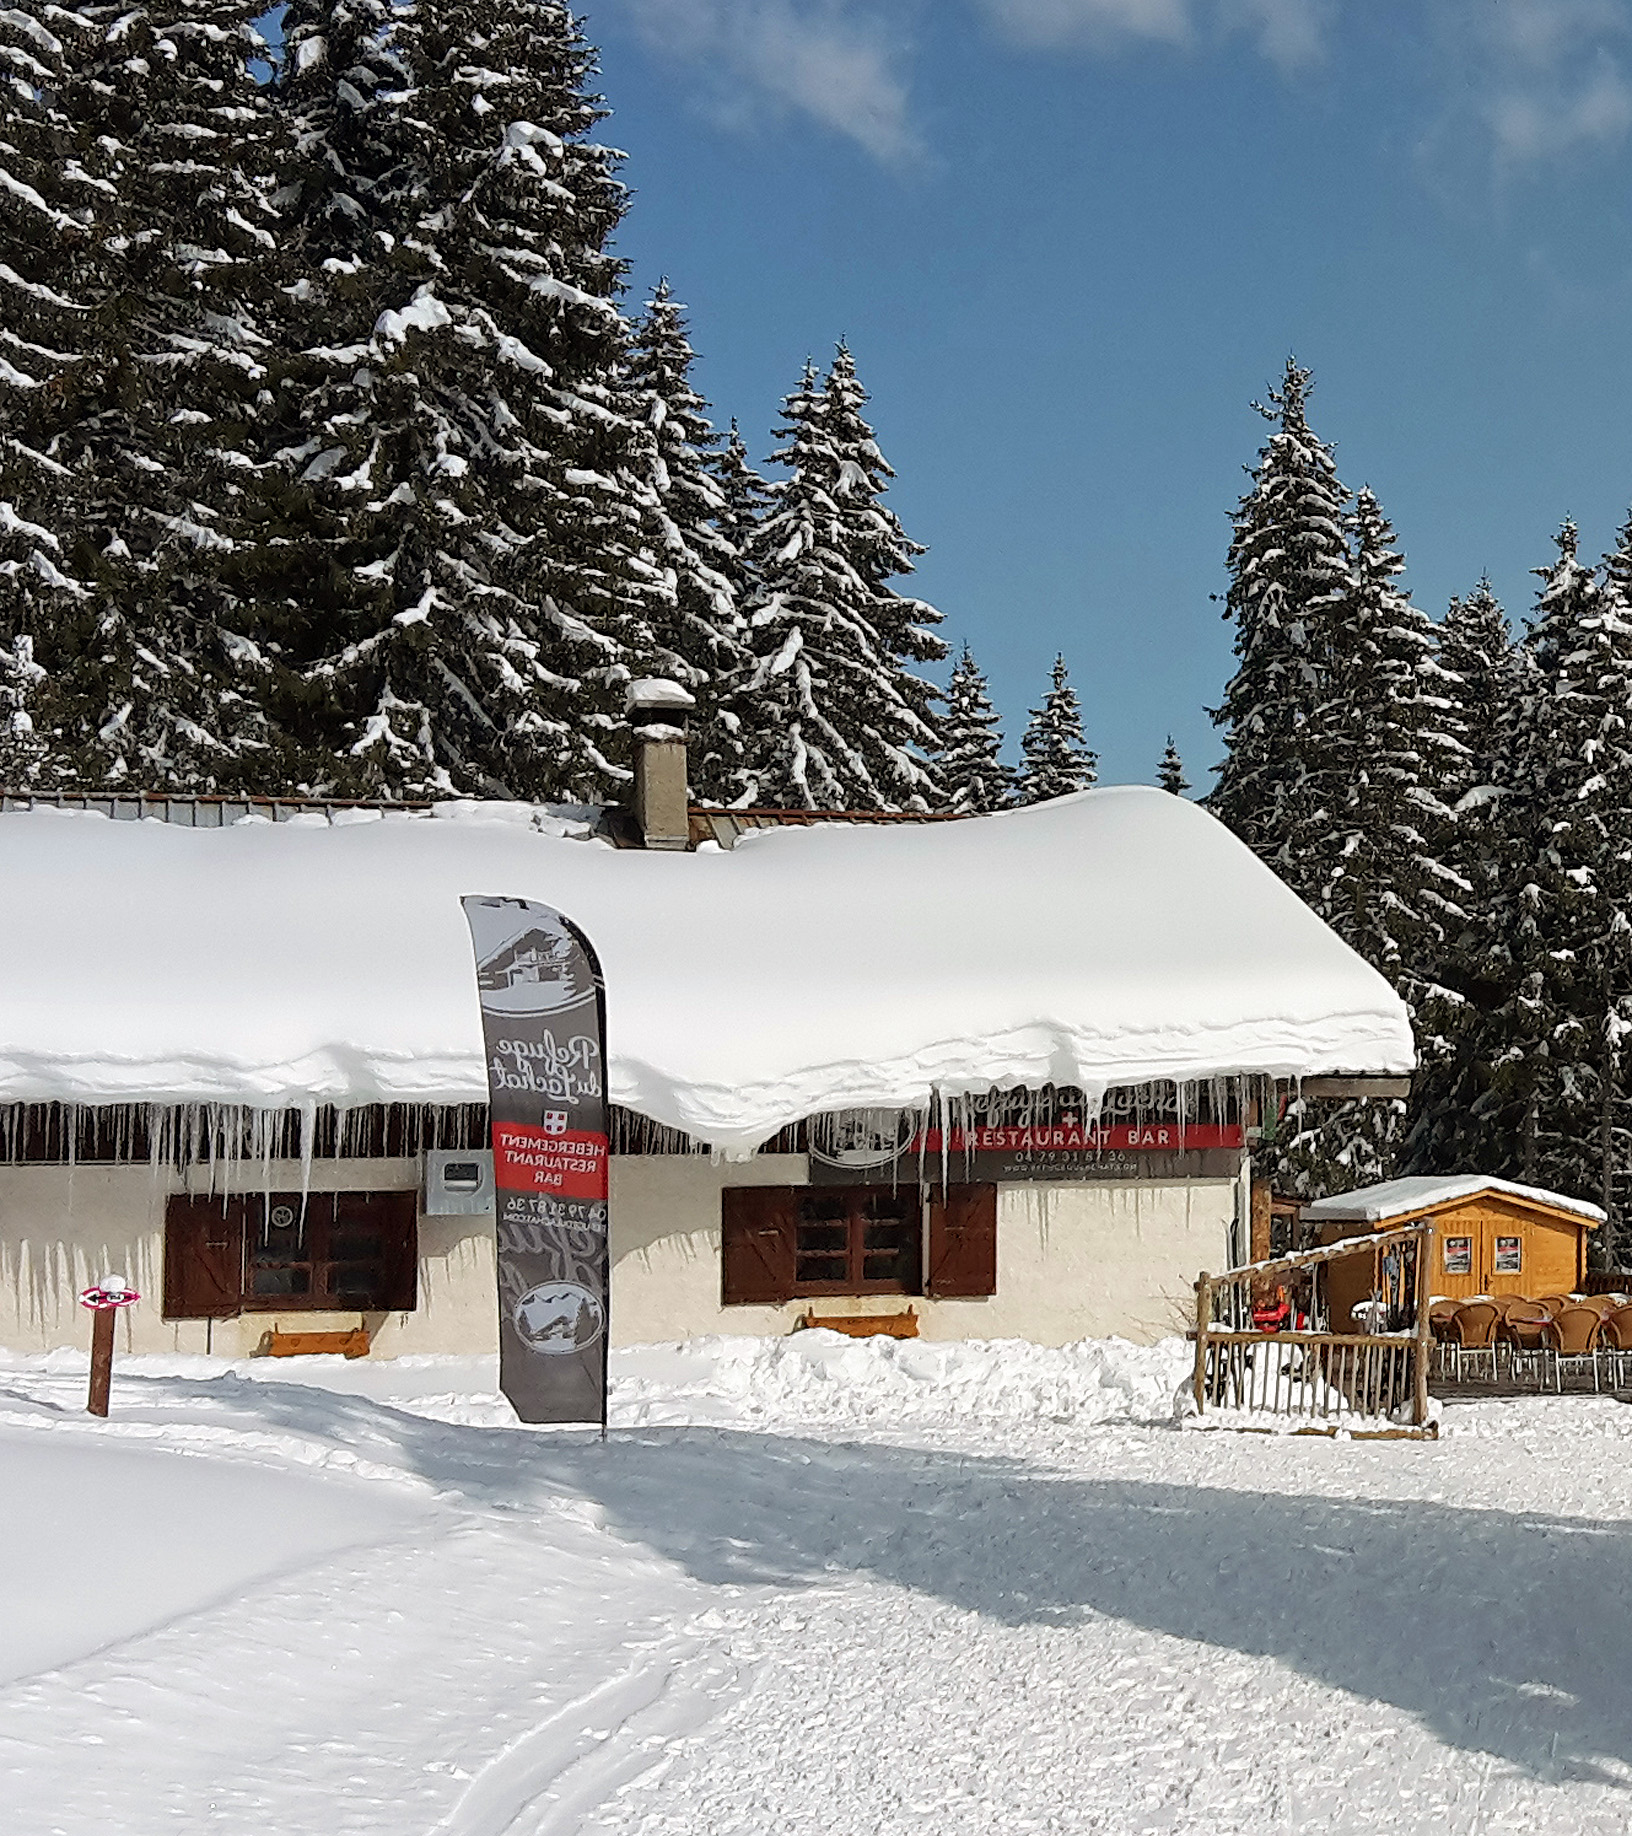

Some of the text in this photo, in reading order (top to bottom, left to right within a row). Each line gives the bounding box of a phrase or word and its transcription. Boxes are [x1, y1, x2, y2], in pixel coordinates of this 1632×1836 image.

[967, 1129, 1170, 1147] RESTAURANT BAR
[1039, 1151, 1056, 1162] 79
